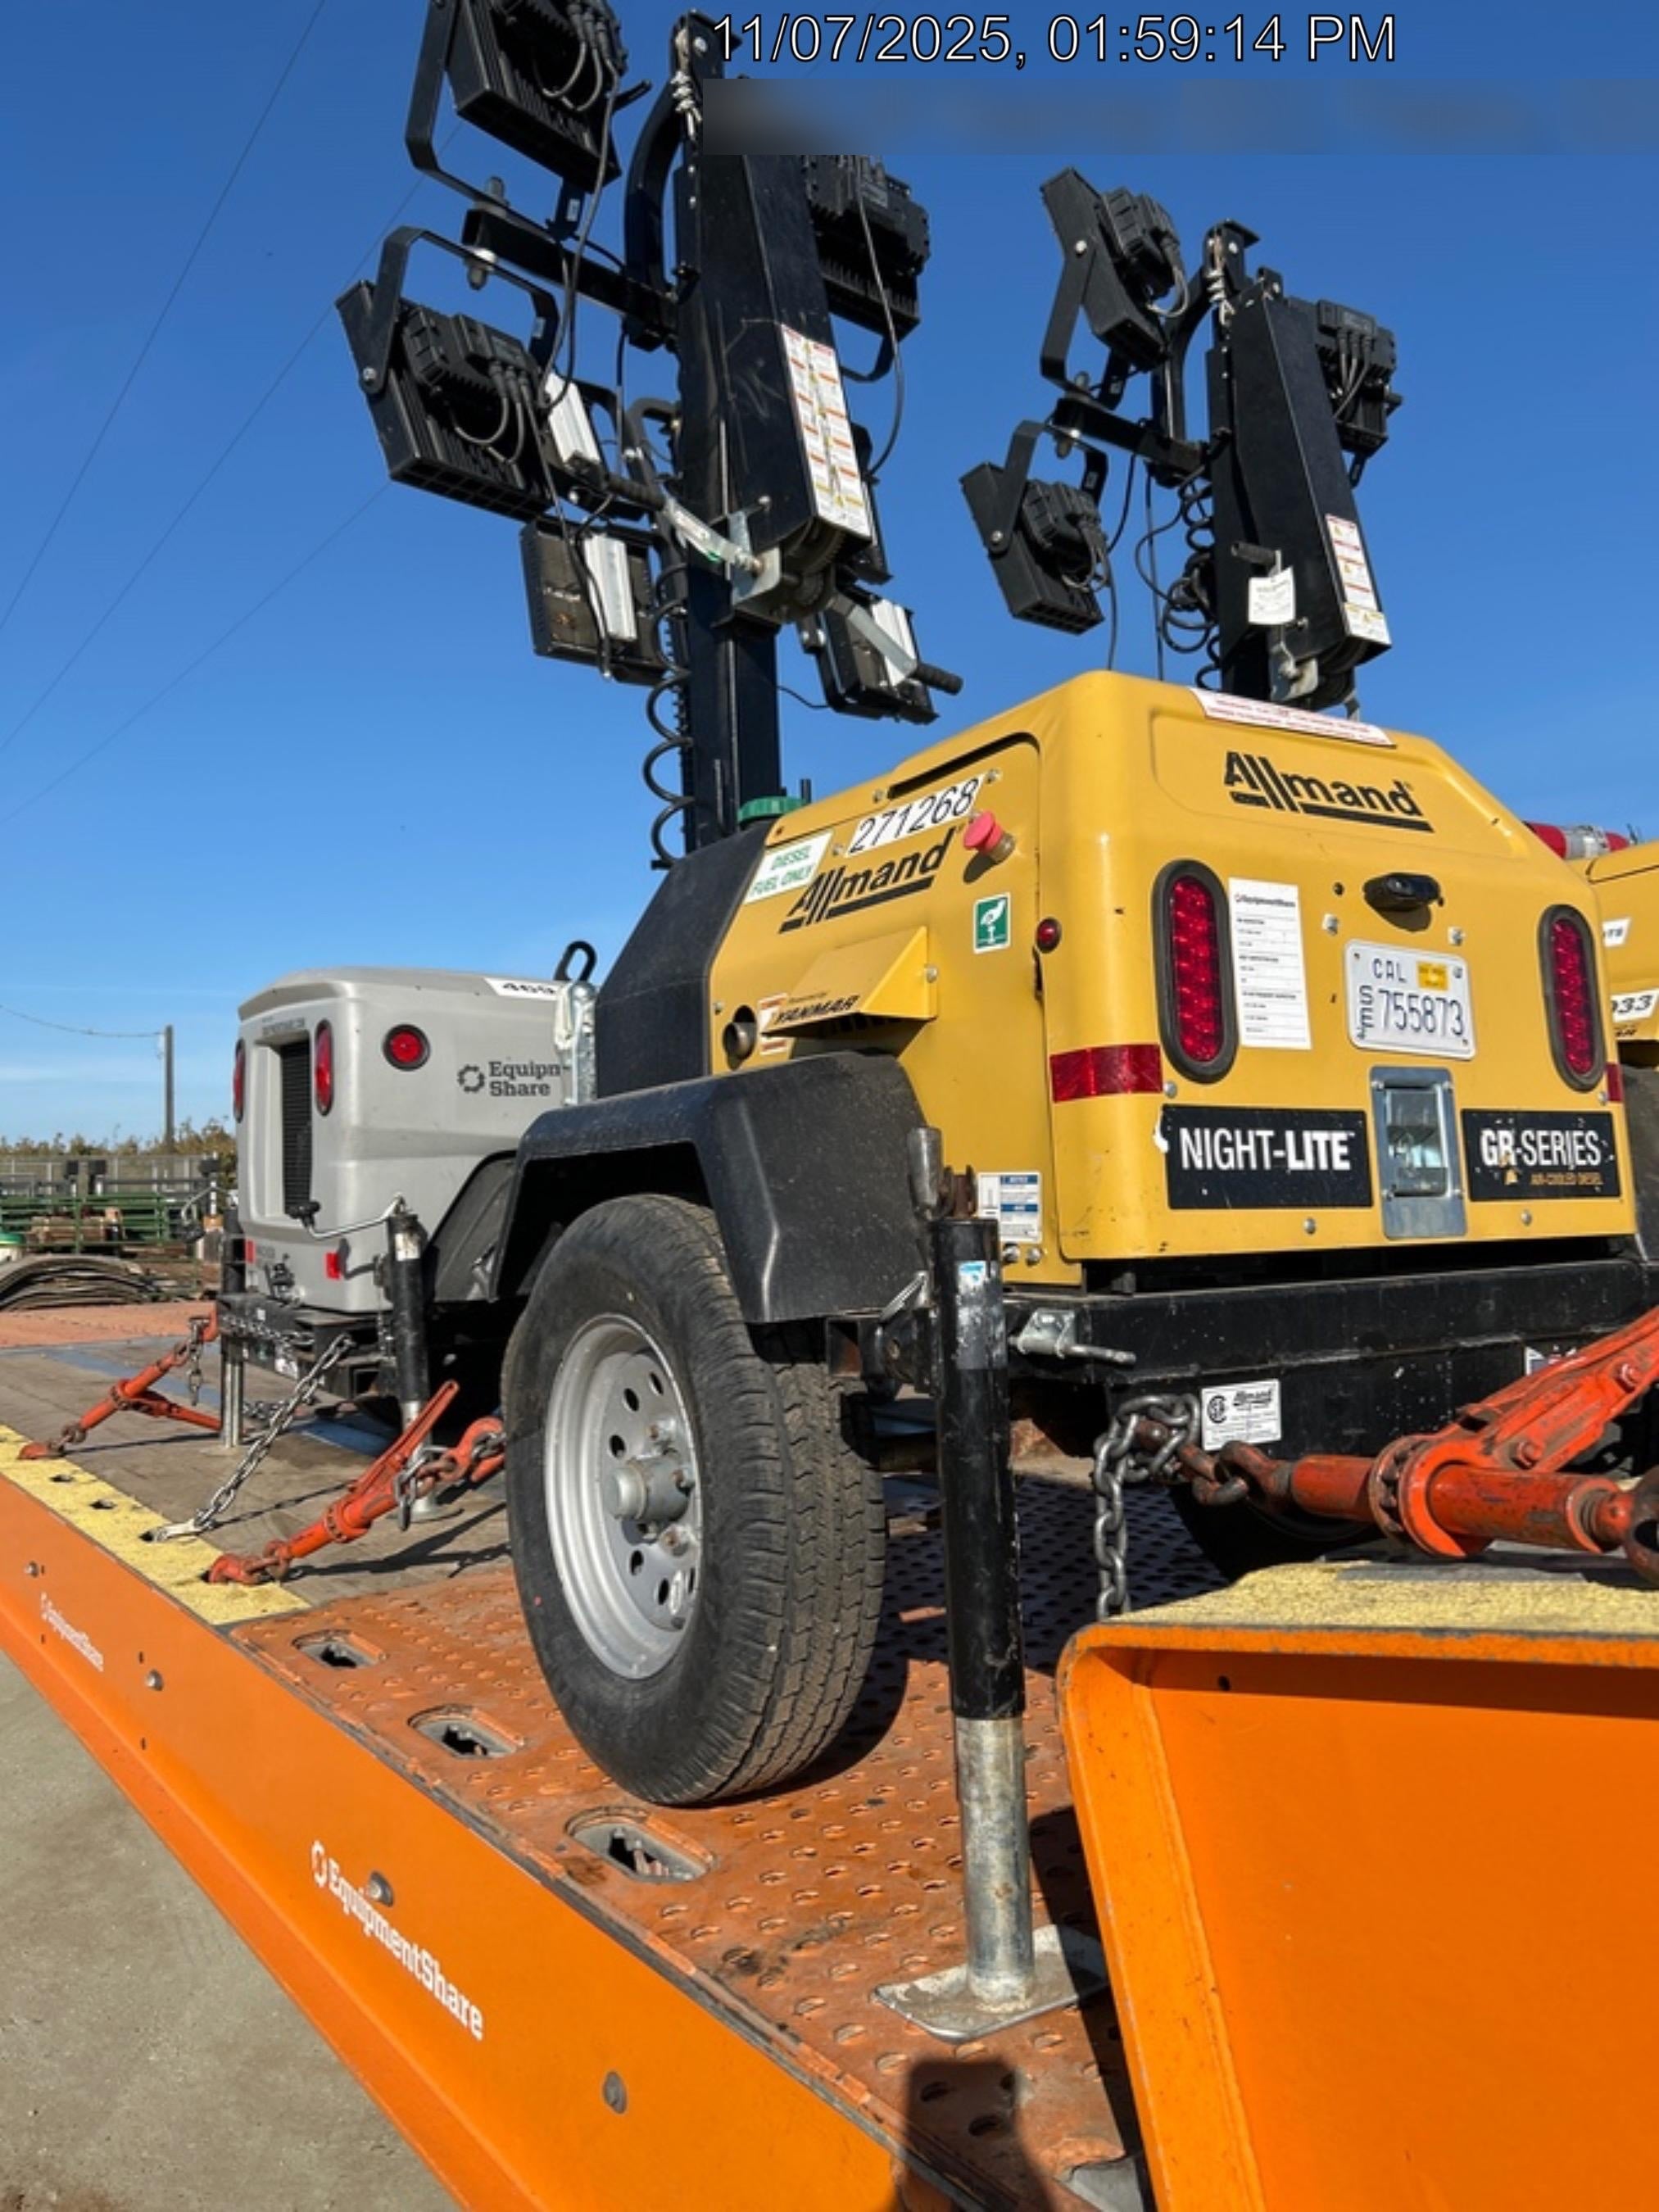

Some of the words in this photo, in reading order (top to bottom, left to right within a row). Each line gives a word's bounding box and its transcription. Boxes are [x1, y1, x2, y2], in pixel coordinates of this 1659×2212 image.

[1223, 751, 1424, 814] Allmand
[849, 777, 979, 854] 271268
[783, 825, 957, 928] Allmand
[1372, 958, 1407, 984] CAL
[1378, 988, 1464, 1037] 755873
[489, 1081, 551, 1096] Share
[1179, 1126, 1352, 1172] NIGHT-LITE
[1480, 1127, 1602, 1167] GR-SERIES
[328, 1856, 484, 2042] EquipmentShare
